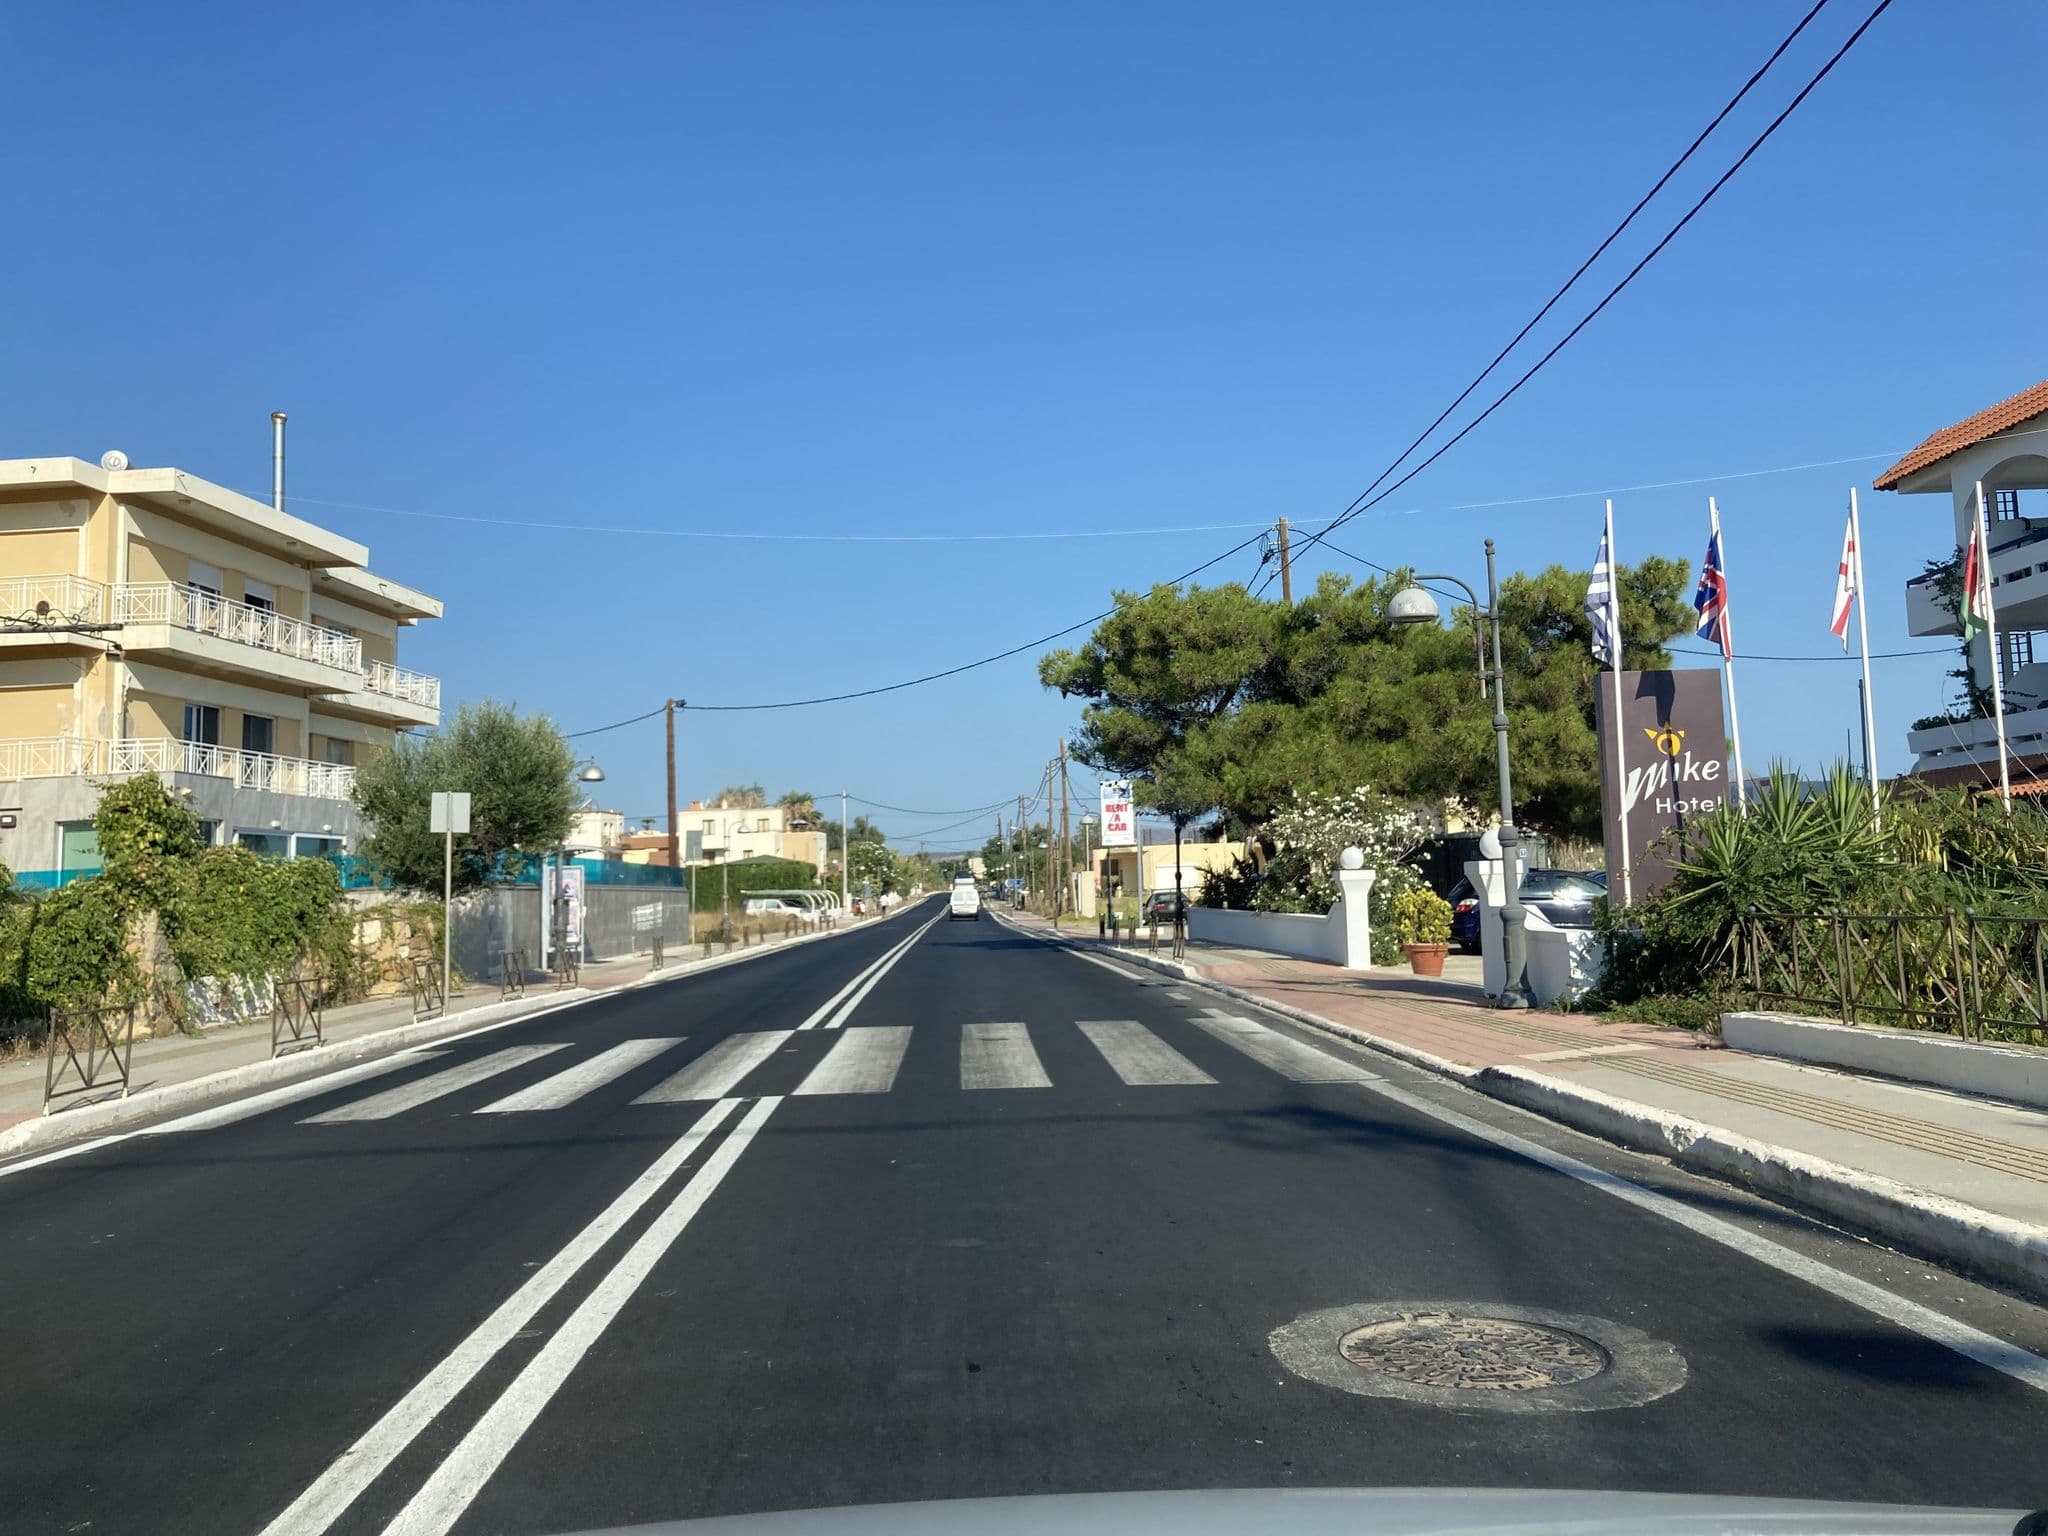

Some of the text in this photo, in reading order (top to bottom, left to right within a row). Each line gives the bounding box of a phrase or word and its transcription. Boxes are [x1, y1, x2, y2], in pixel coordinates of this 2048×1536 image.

[1618, 751, 1720, 822] Mike
[1105, 803, 1129, 812] RENT
[1655, 796, 1723, 814] Hotel
[1114, 814, 1121, 822] A
[1107, 823, 1127, 831] CAR
